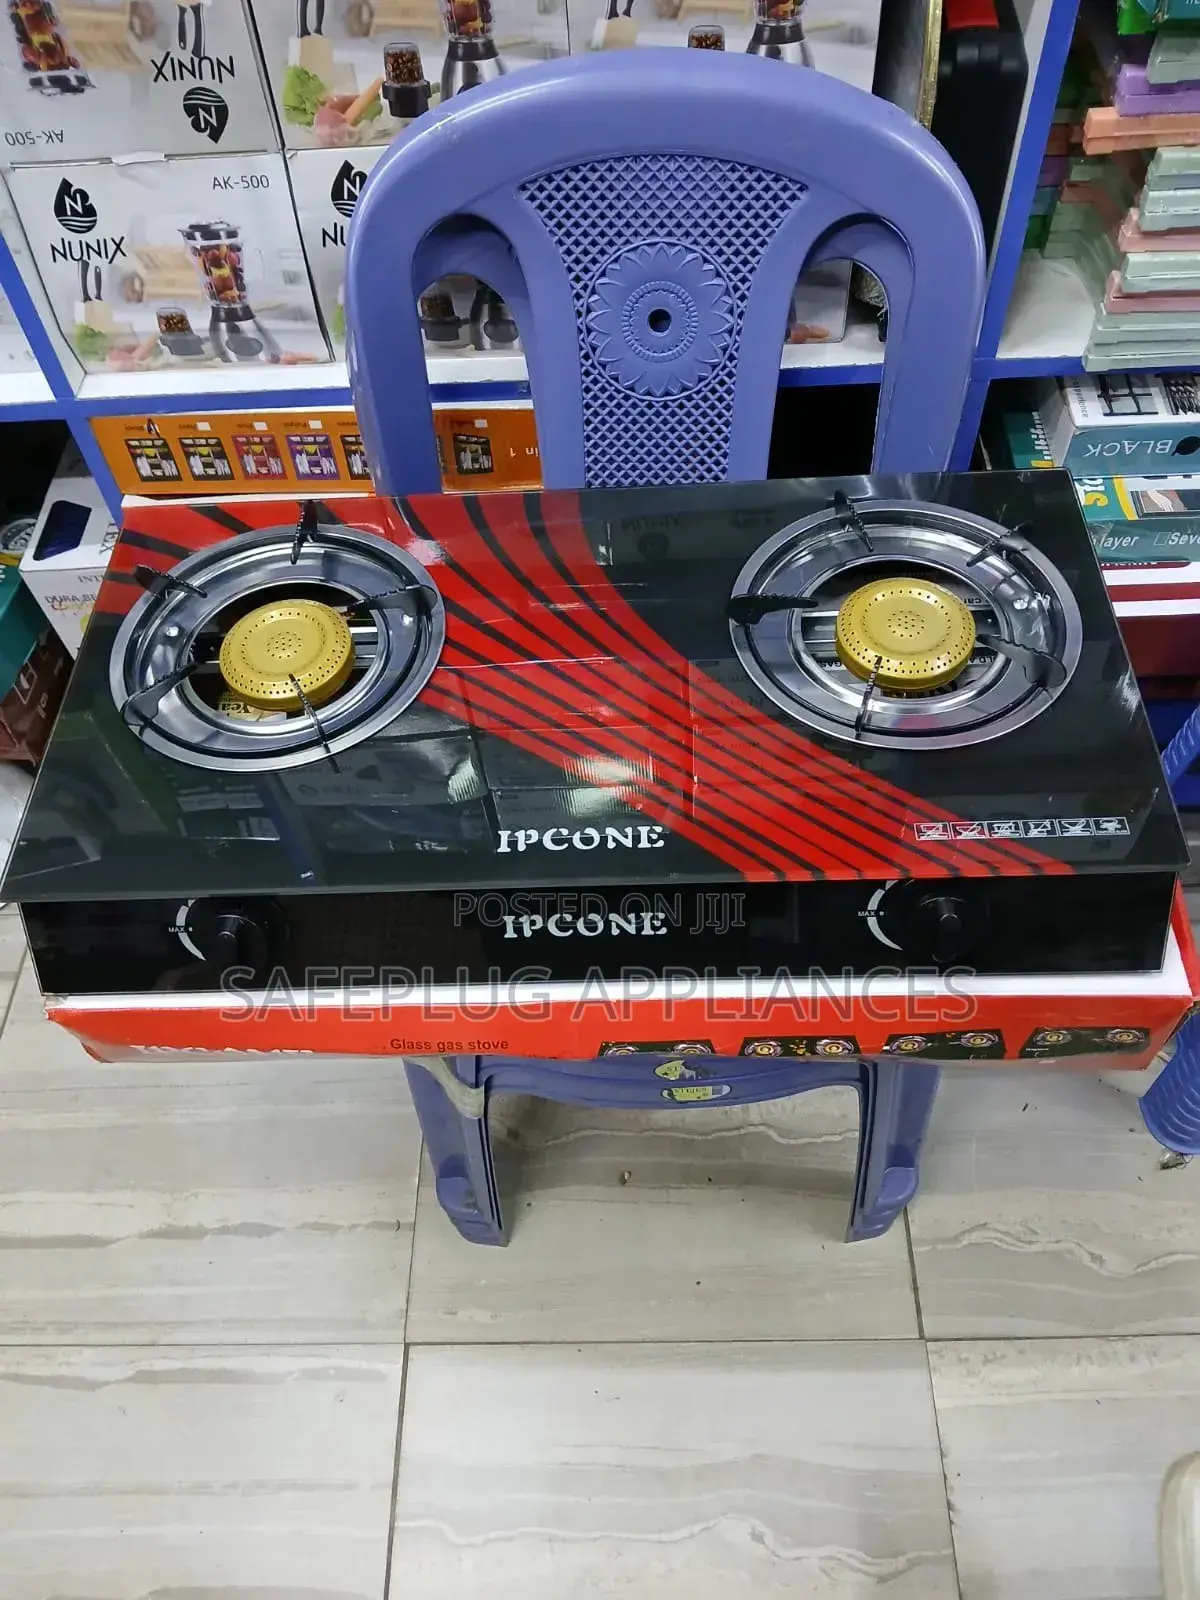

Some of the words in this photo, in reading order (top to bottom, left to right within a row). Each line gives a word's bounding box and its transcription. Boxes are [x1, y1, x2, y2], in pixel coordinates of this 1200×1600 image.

[151, 51, 235, 83] NUNIX
[5, 129, 64, 146] AK-500
[212, 174, 270, 191] AK-500
[50, 236, 127, 263] NUNIX
[1084, 439, 1173, 457] BLACK
[496, 826, 665, 853] IPCONE
[502, 912, 668, 939] IPCONE
[390, 1038, 432, 1050] Glass
[437, 1040, 464, 1053] gas
[467, 1039, 509, 1050] stove
